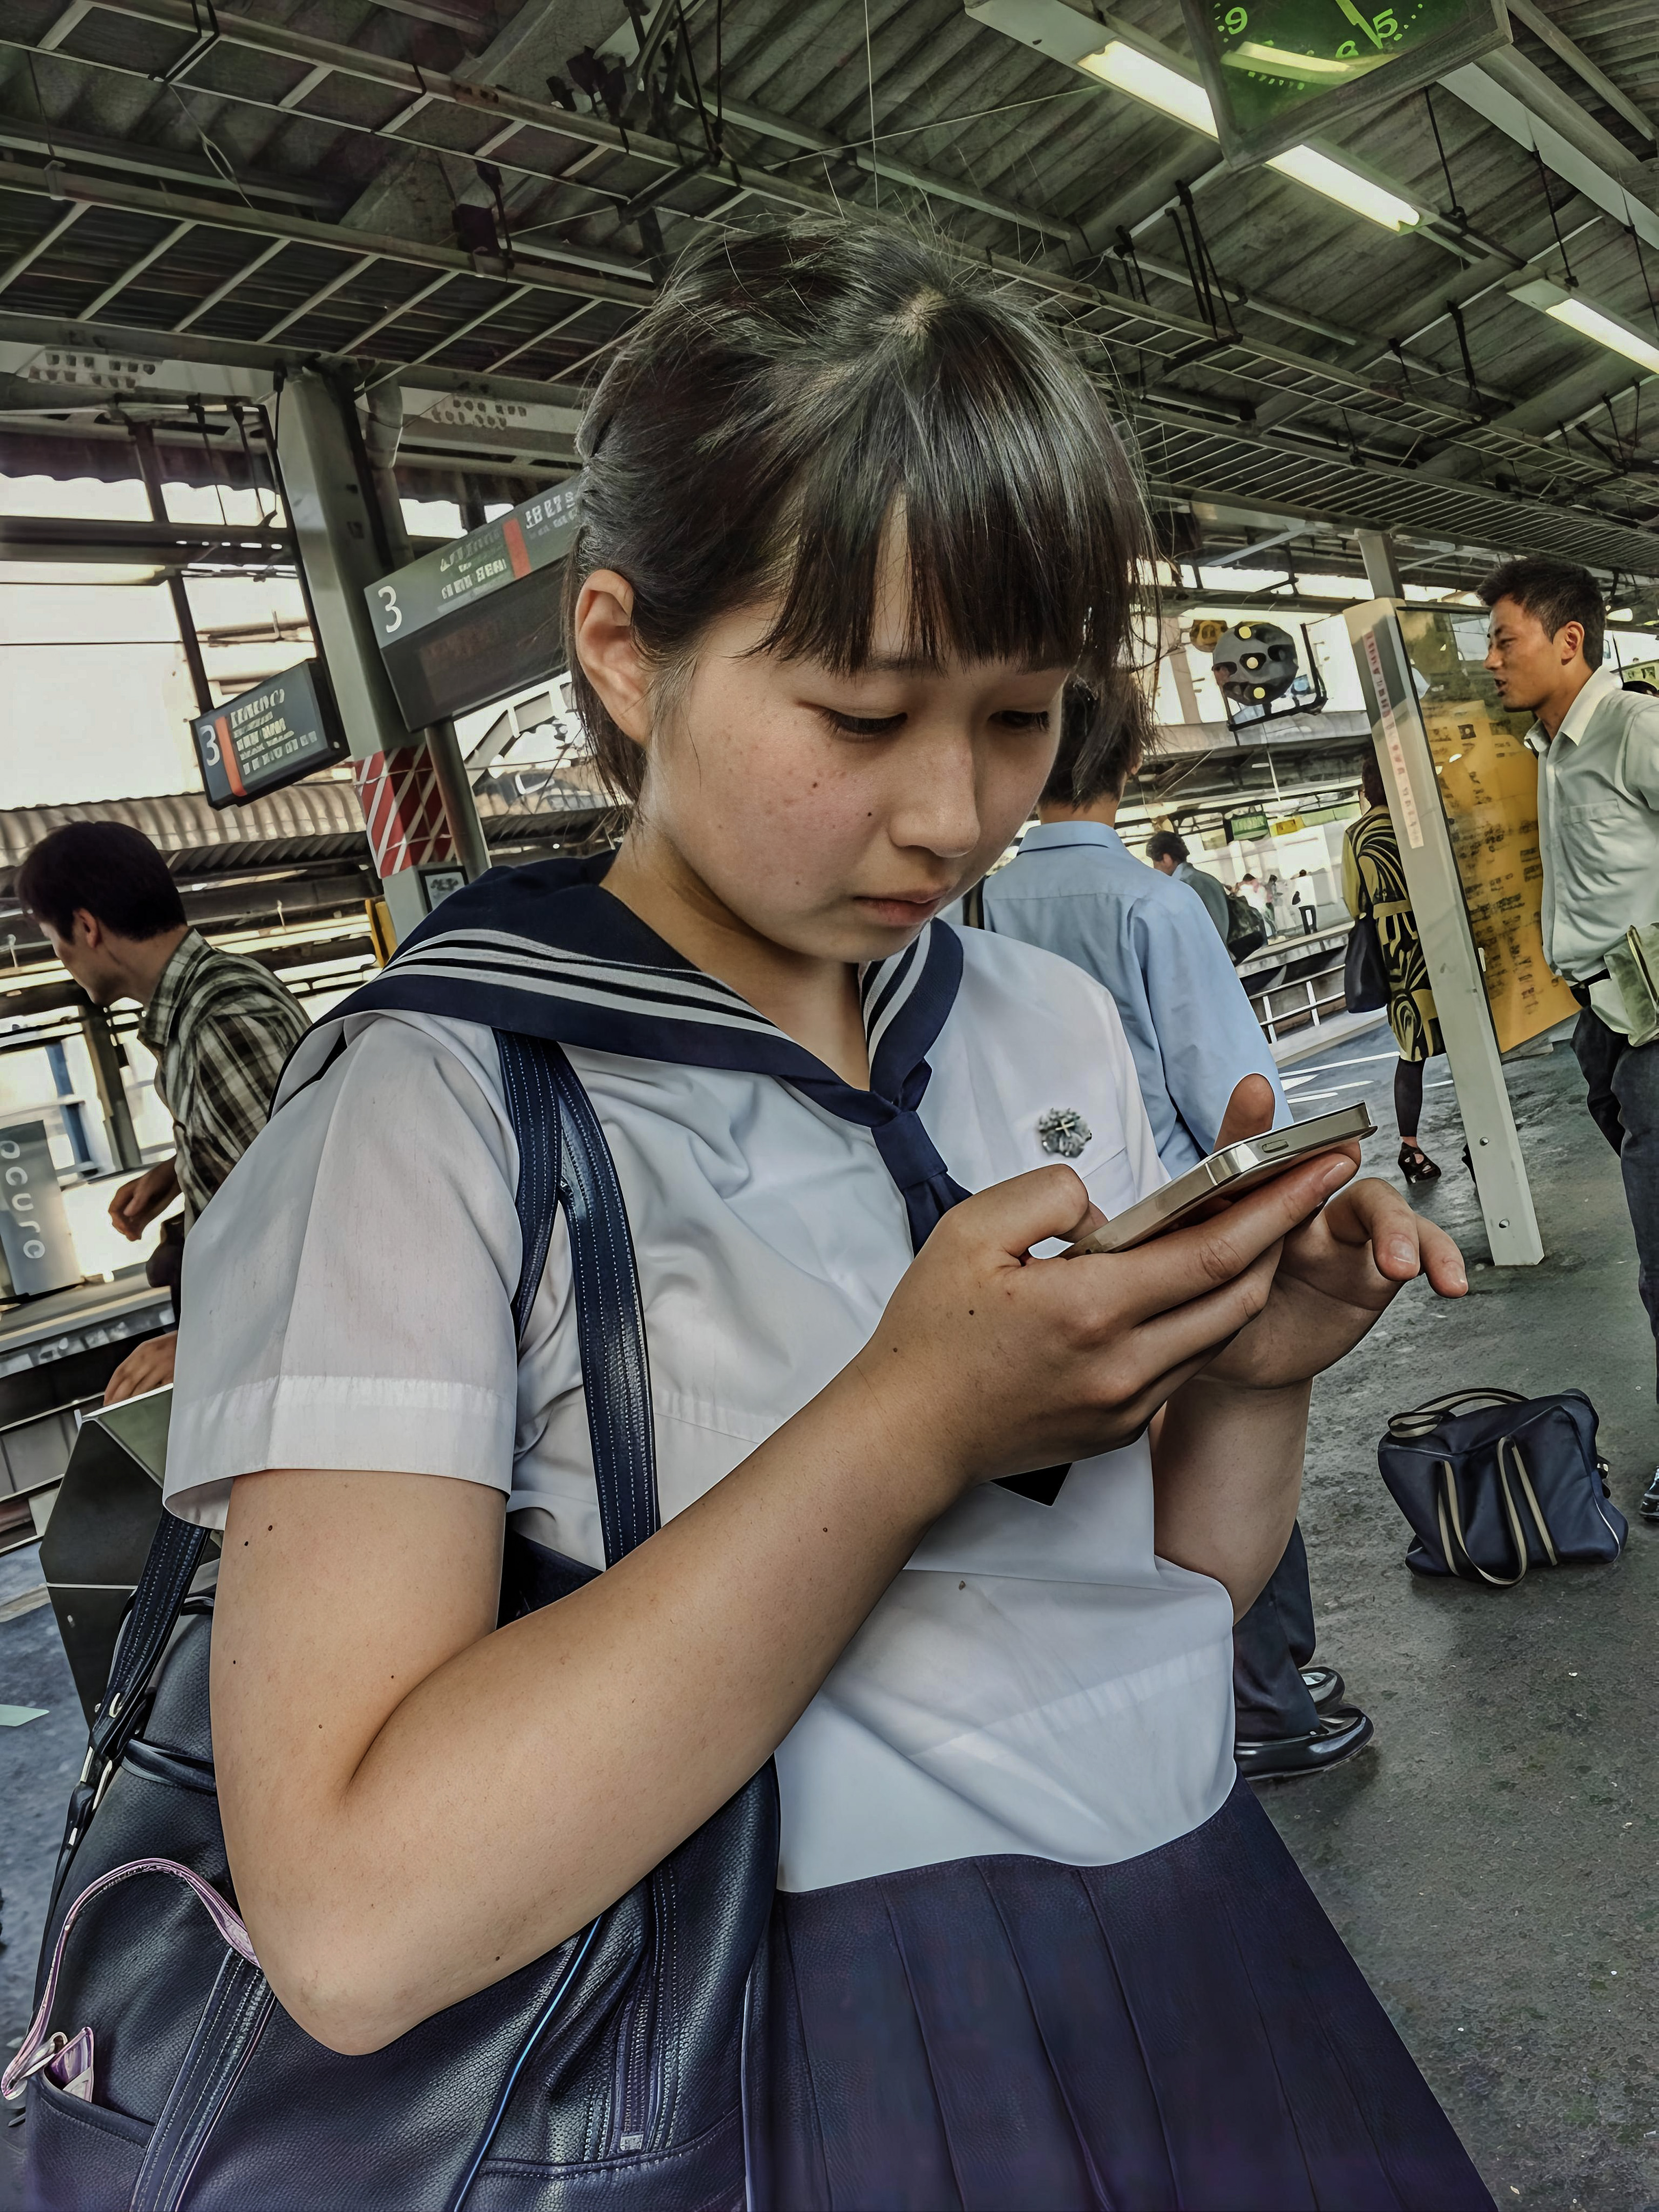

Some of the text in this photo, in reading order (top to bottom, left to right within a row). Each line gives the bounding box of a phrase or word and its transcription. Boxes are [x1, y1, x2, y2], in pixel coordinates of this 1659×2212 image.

[1224, 7, 1248, 34] 9
[1372, 8, 1398, 38] 5
[378, 585, 403, 633] 3
[199, 725, 221, 767] 3
